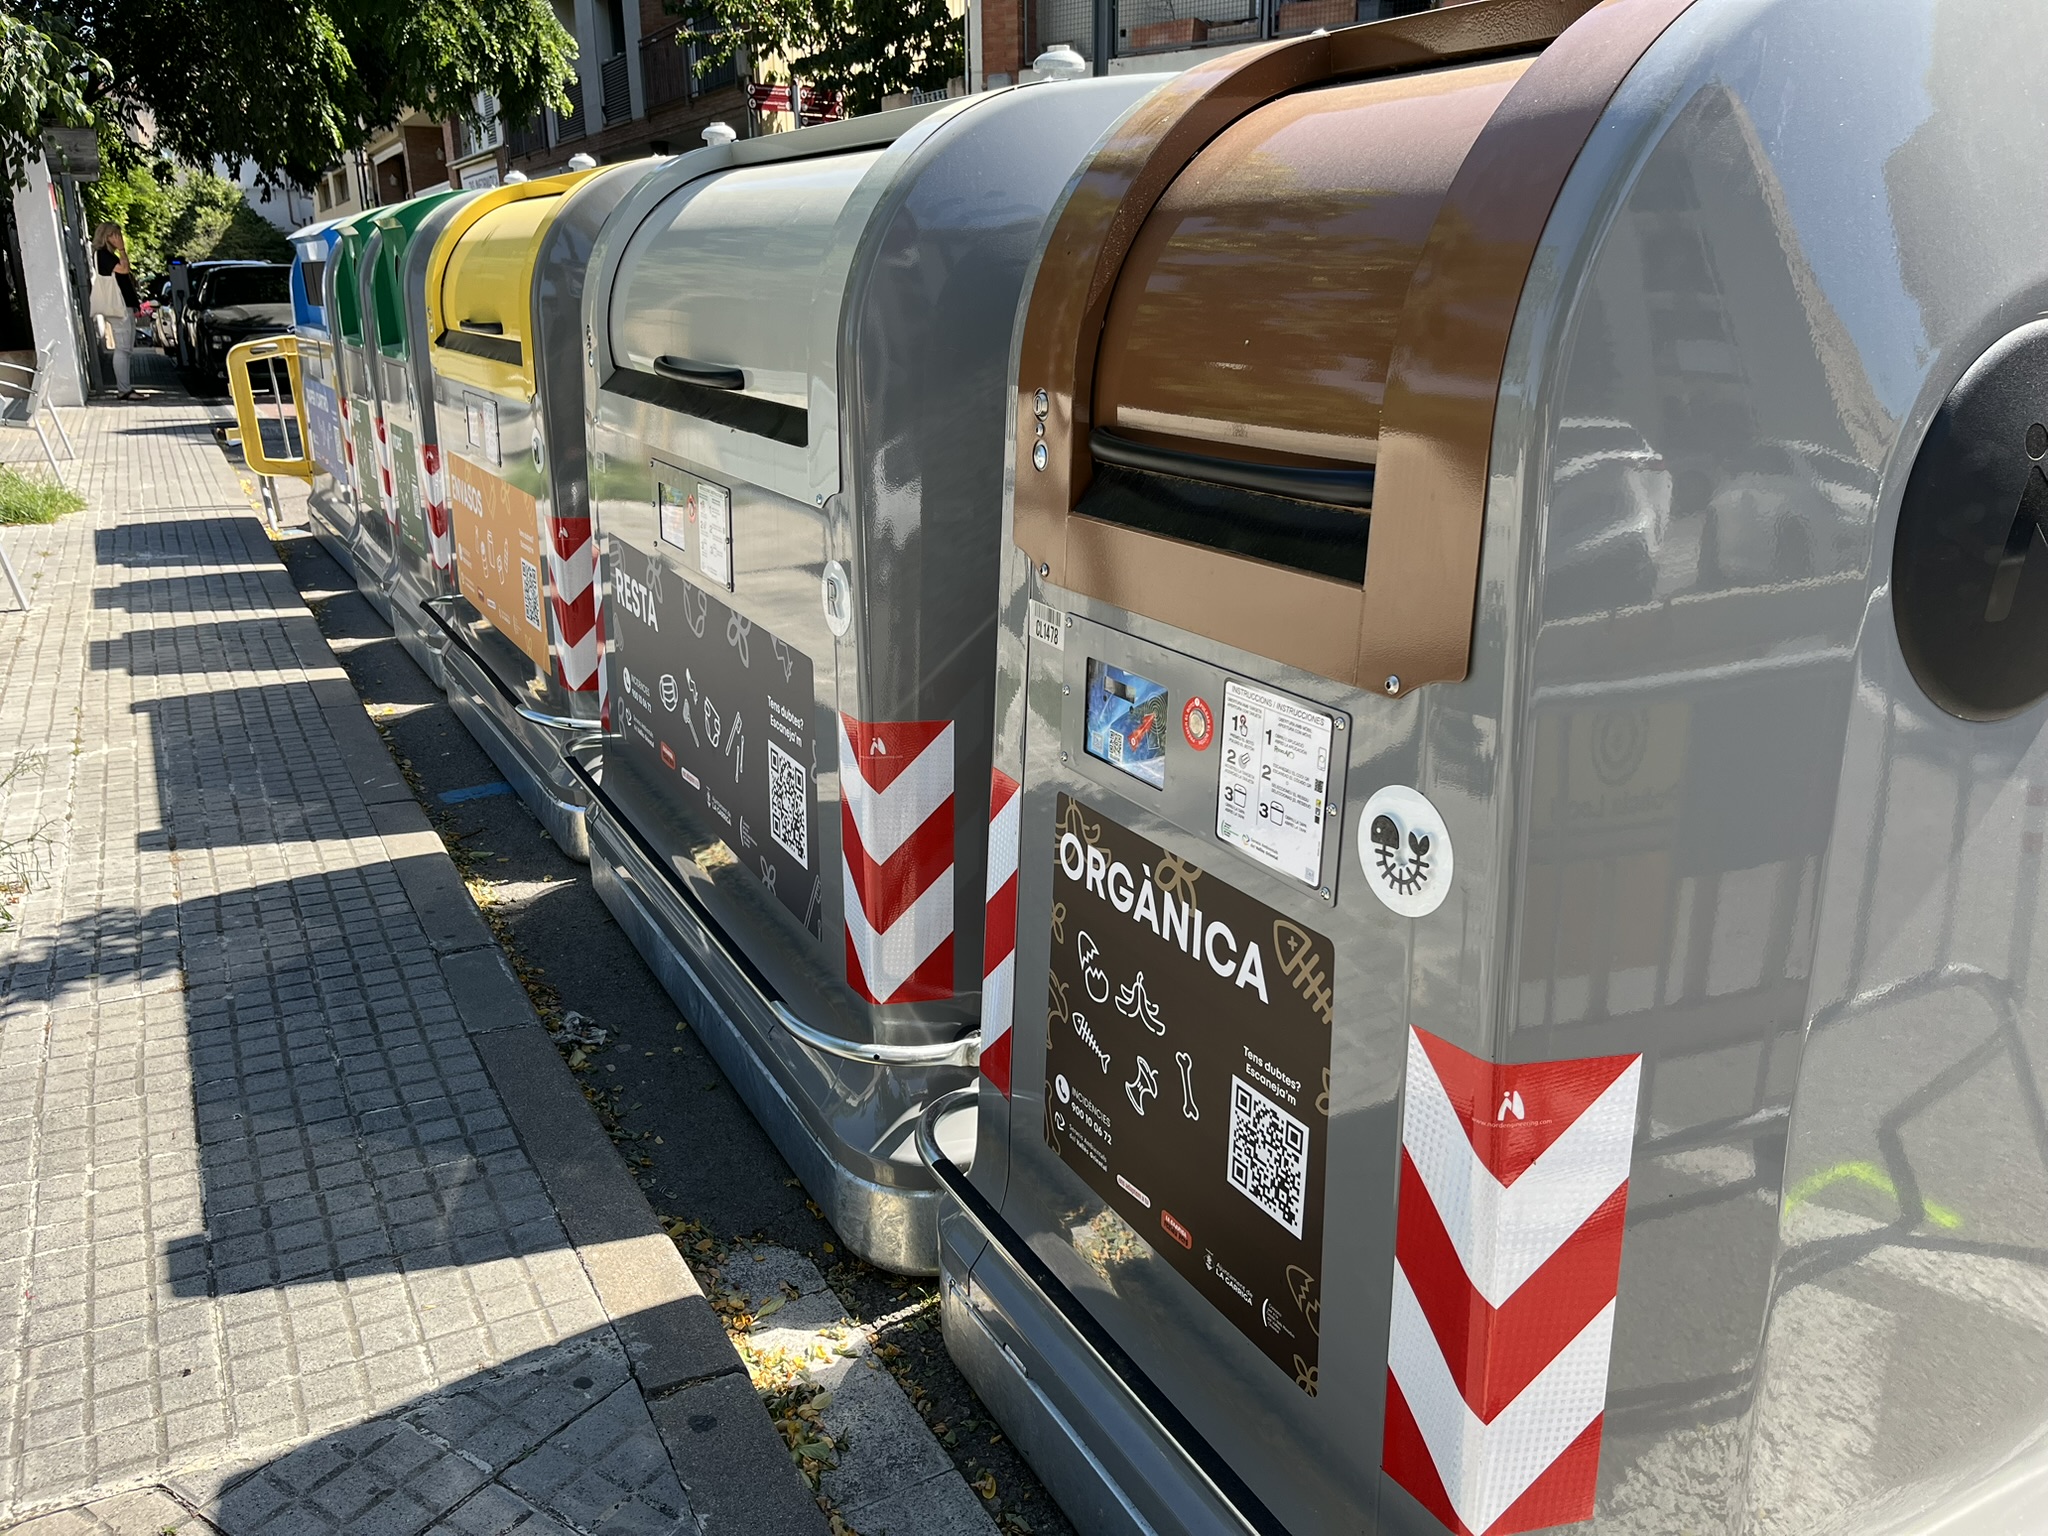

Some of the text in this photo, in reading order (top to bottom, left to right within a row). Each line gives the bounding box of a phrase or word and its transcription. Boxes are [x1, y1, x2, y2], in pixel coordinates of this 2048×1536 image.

[451, 473, 483, 518] ENVASOS
[615, 567, 659, 633] RESTA
[1035, 620, 1059, 645] CL1478
[768, 695, 804, 730] Tens dubtes?
[1231, 686, 1272, 707] INSTRUCCIONS
[1276, 704, 1325, 726] INSTRUCCIONES
[1232, 716, 1238, 731] 1
[770, 713, 803, 748] Escaneja'm
[1266, 730, 1272, 745] 1
[1227, 749, 1236, 764] 2
[1262, 765, 1271, 781] 2
[1224, 786, 1233, 801] 3
[1259, 803, 1268, 818] 3
[1059, 832, 1269, 1005] ORGÀNICA
[1243, 1045, 1301, 1092] Tens dubtes?
[1246, 1063, 1296, 1106] Escaneja'm
[1071, 1087, 1111, 1128] INCIDÈNCIES
[1071, 1101, 1112, 1146] 900 10 06 72
[1471, 1117, 1553, 1129] www.nordengineering.com
[1216, 1268, 1253, 1306] LA GARRIGA
